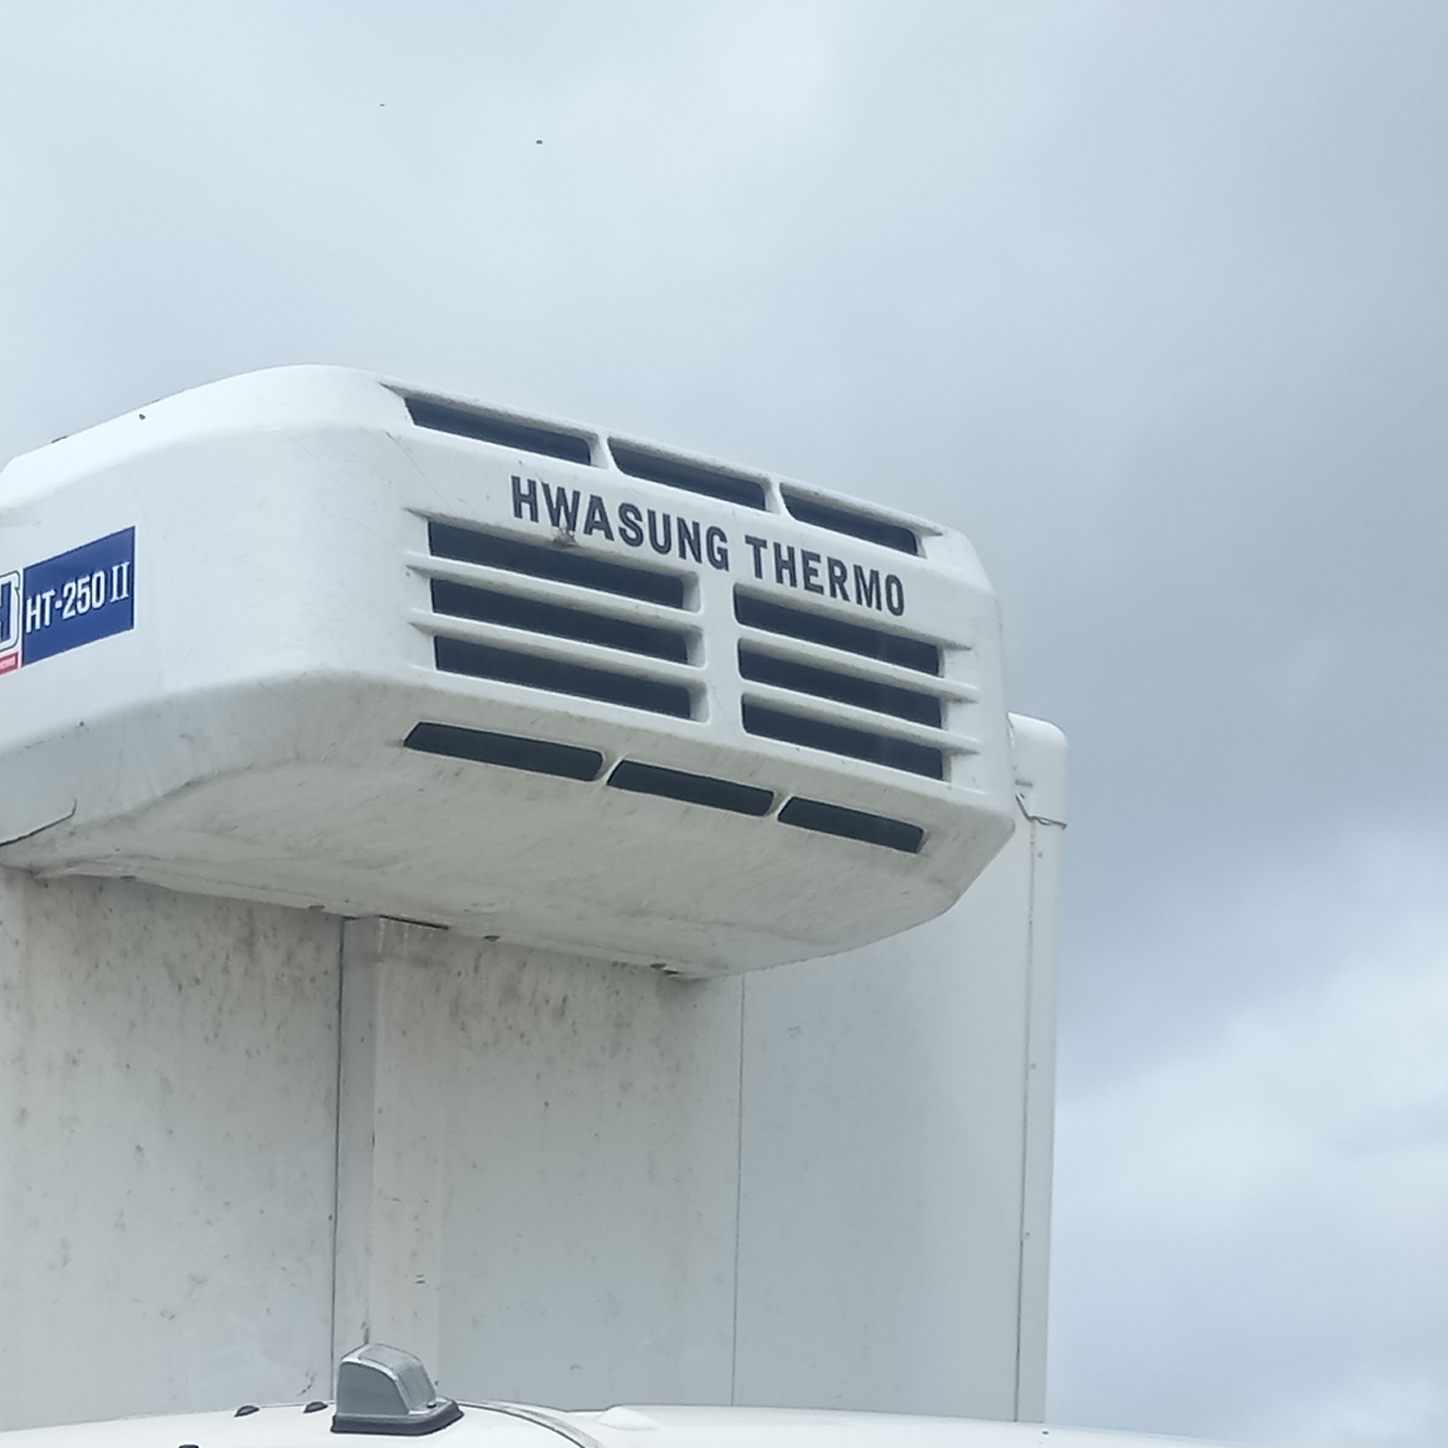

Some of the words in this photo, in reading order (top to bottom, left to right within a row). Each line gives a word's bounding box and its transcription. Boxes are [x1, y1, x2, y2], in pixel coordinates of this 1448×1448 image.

[510, 474, 730, 573] HWASUNG
[745, 534, 905, 617] THERMO
[25, 570, 105, 634] HT-250
